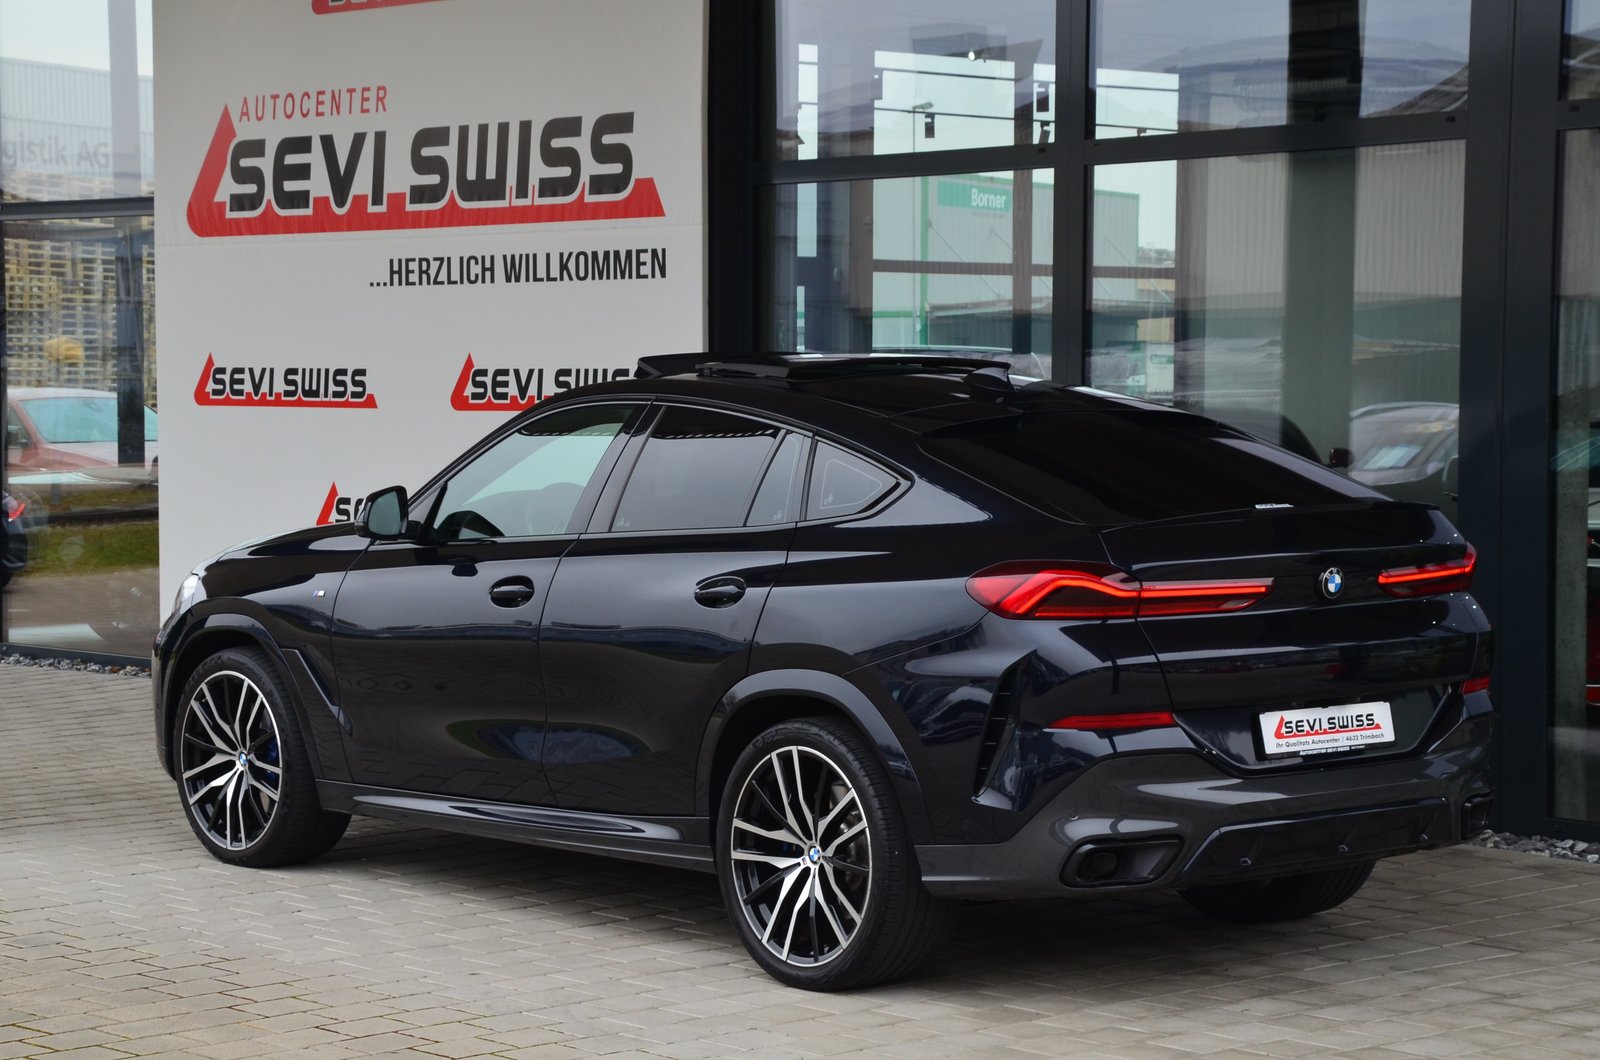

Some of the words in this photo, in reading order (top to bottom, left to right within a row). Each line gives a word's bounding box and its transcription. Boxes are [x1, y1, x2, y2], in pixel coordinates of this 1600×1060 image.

[239, 86, 387, 122] AUTOCENTER
[76, 140, 110, 169] AG
[229, 130, 387, 213] SEVI
[408, 111, 635, 206] SWISS
[971, 188, 1007, 209] Borner
[502, 248, 667, 284] WILLKOMMEN
[211, 367, 274, 398] SEVI
[283, 368, 367, 400] SWISS
[470, 368, 544, 403] SEVI
[1284, 718, 1322, 734] SEVI
[1327, 713, 1375, 730] SWISS
[1311, 737, 1340, 745] Autocenter
[1360, 733, 1385, 741] Trimbach
